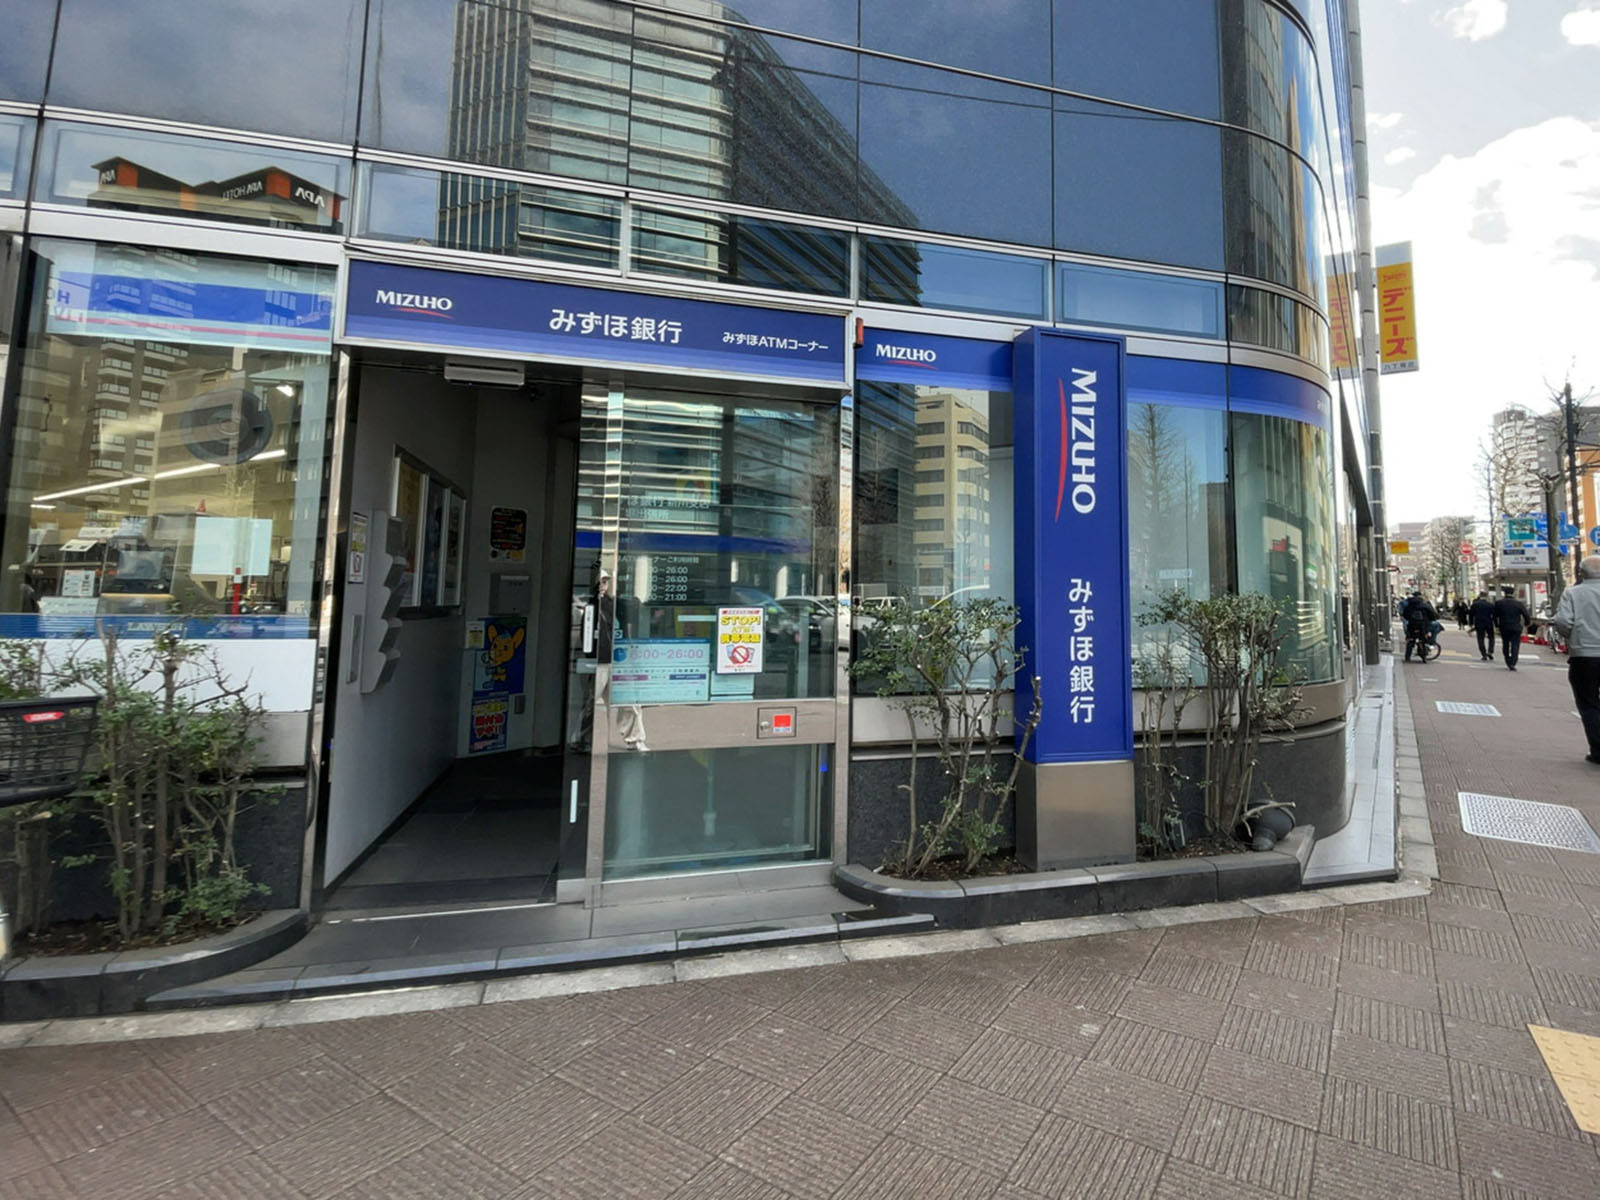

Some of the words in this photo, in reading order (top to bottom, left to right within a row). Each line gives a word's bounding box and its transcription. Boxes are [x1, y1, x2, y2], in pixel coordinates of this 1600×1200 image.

[376, 290, 453, 311] MIZUHO
[549, 308, 683, 344] みずほ銀行
[1383, 286, 1414, 357] デニーズ
[722, 331, 829, 352] みずほATMコーナー
[876, 344, 937, 363] MIZUHO
[1071, 367, 1097, 515] MIZUHO
[1068, 578, 1096, 724] みずほ銀行
